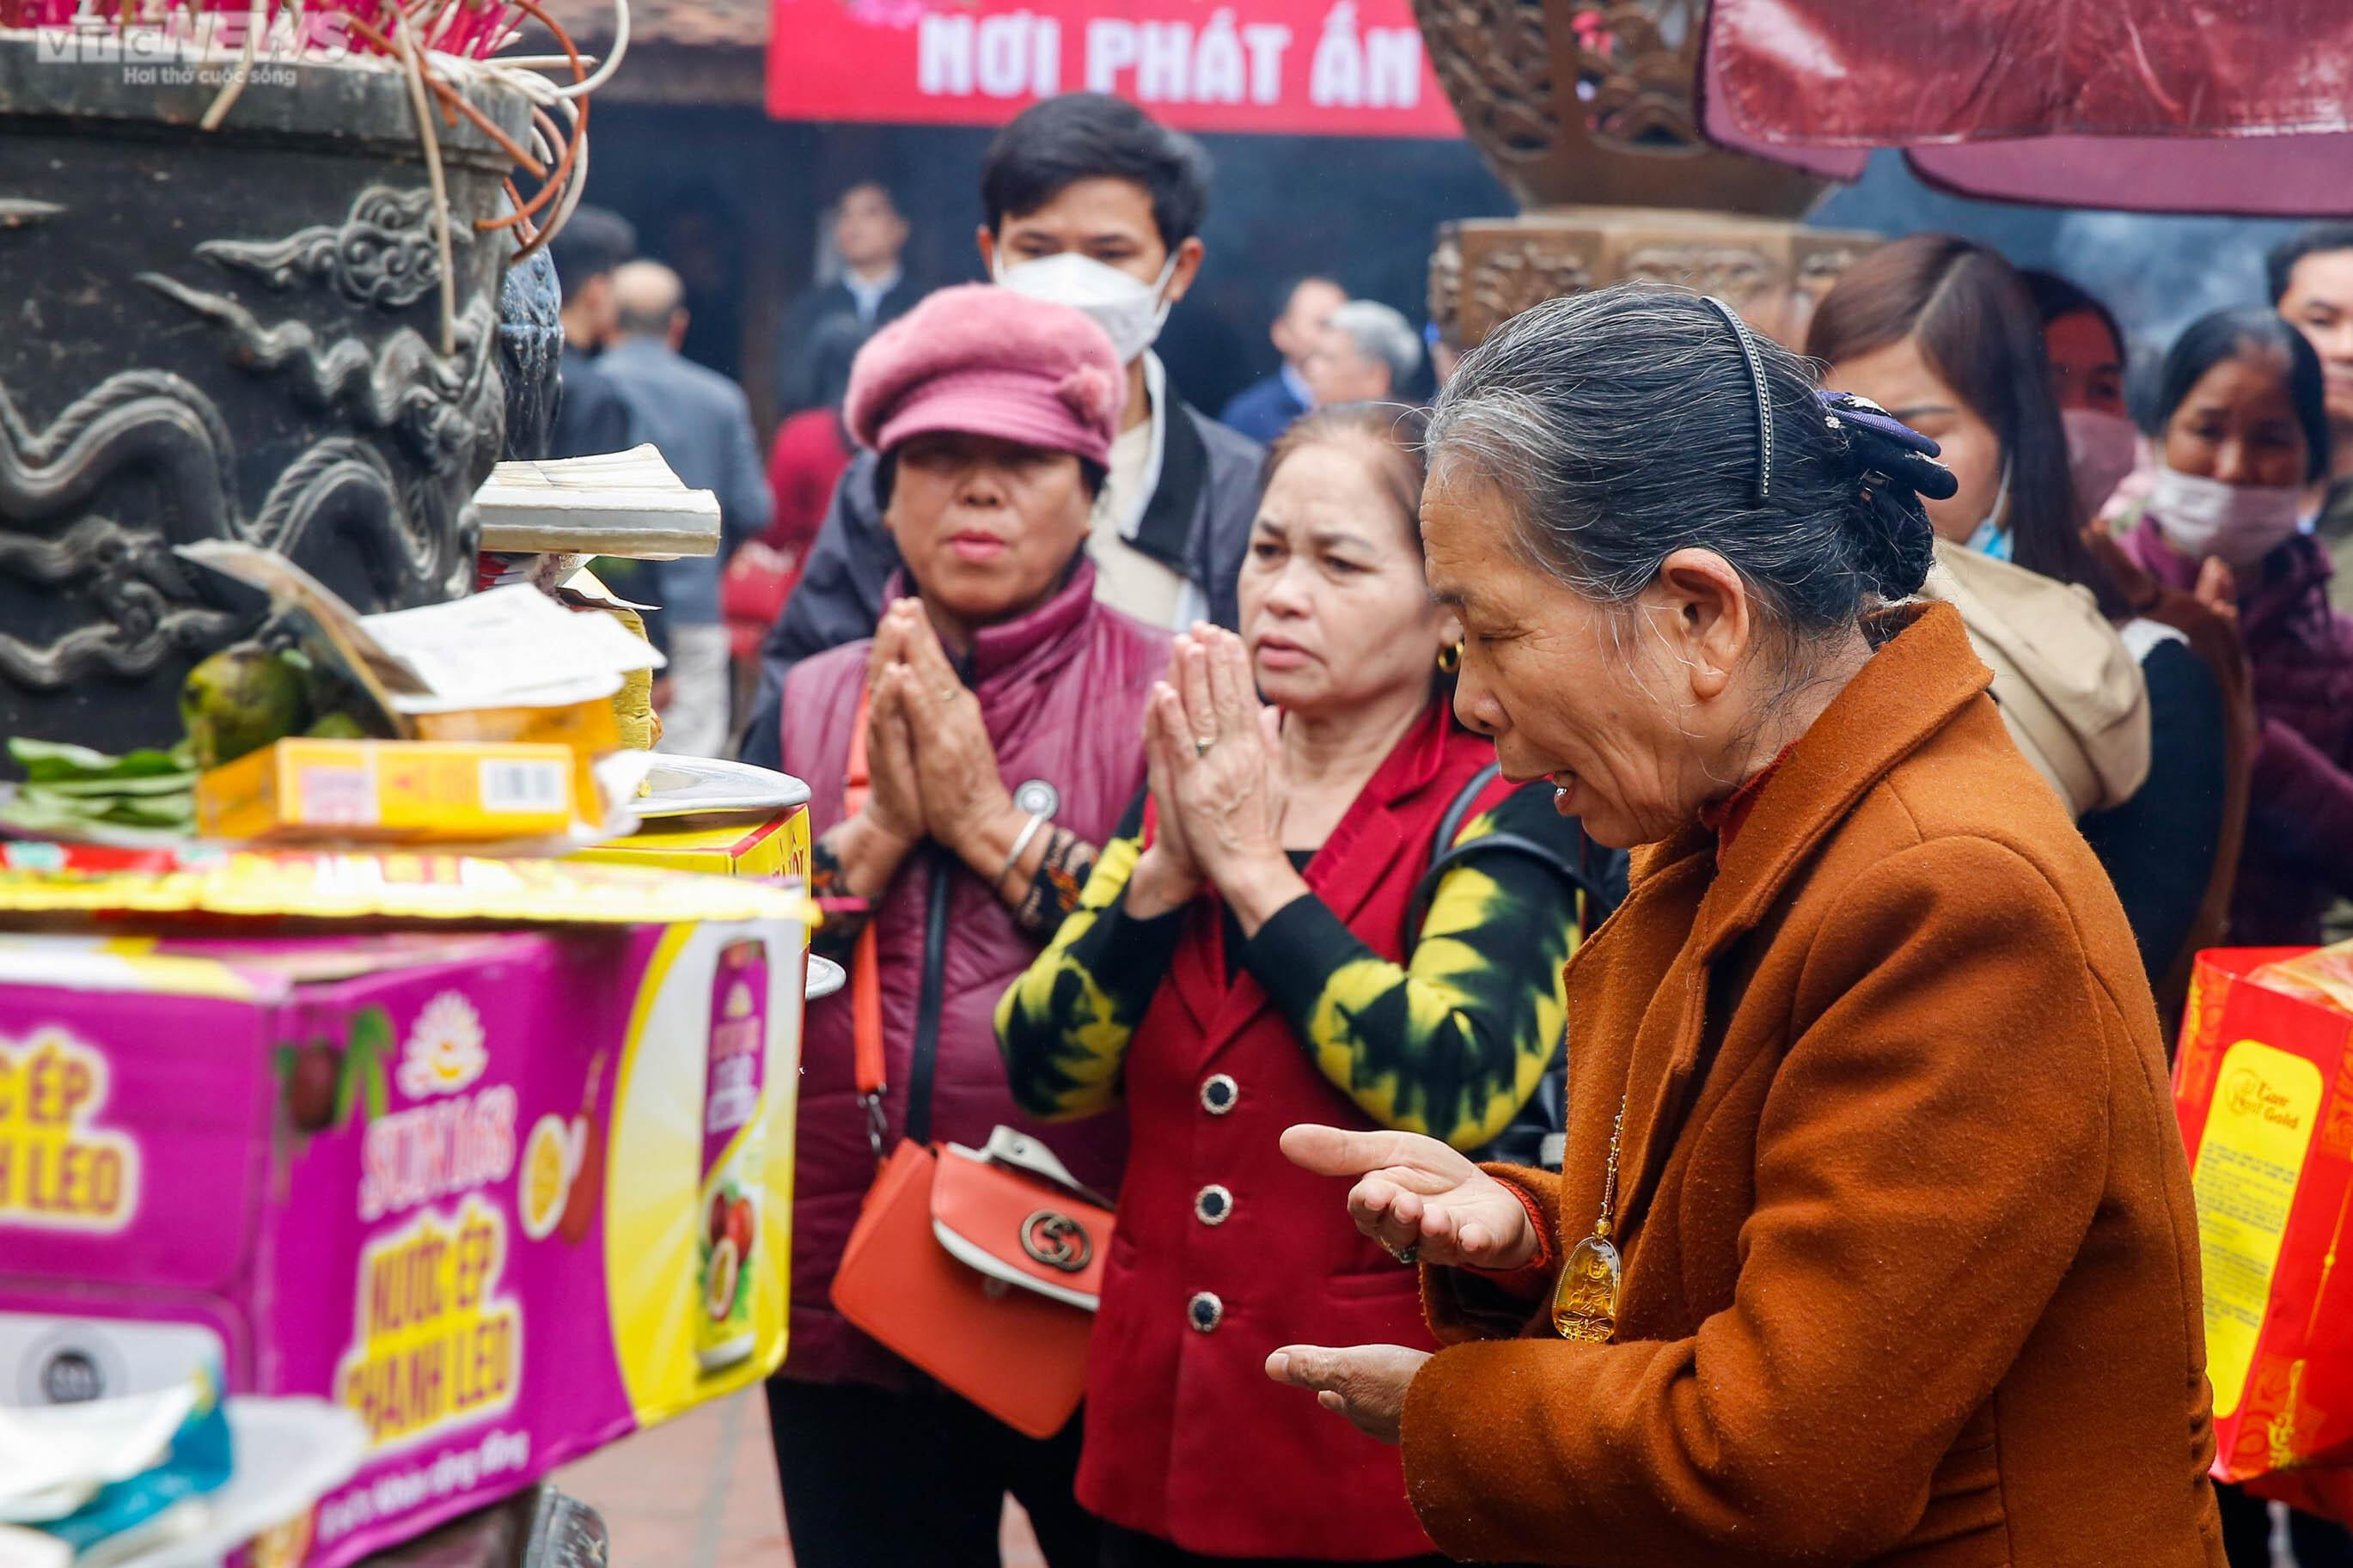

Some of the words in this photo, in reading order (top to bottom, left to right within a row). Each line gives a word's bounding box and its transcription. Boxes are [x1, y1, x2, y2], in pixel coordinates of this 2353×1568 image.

[919, 9, 1060, 100] NƠI
[1085, 7, 1292, 105] PHÁT
[1309, 0, 1421, 109] ẤN
[28, 1140, 124, 1219] LEO
[451, 1309, 512, 1419] LEO
